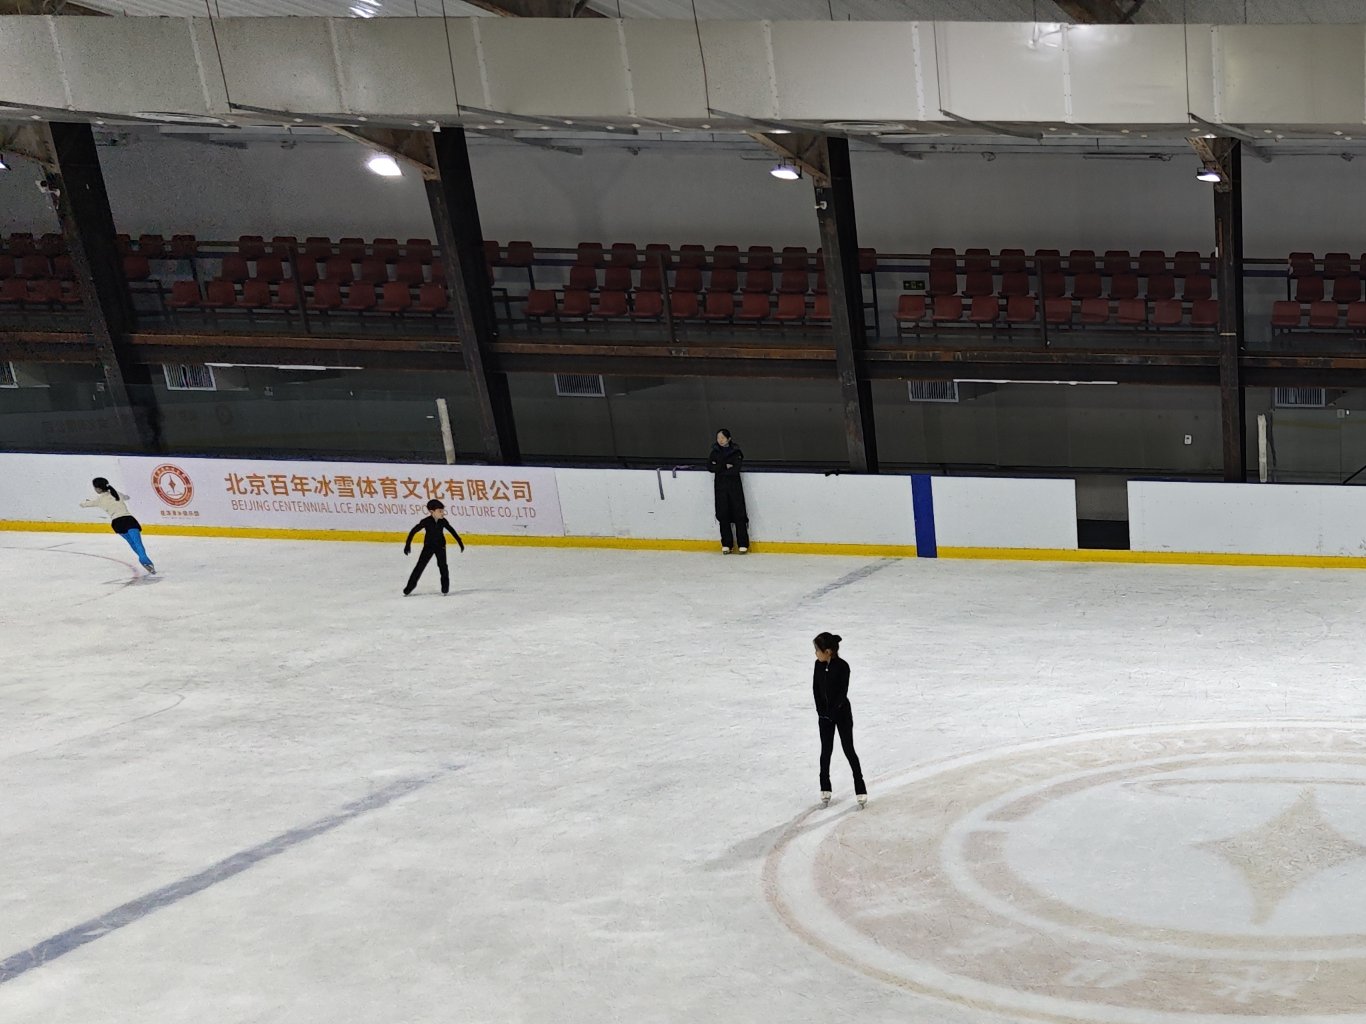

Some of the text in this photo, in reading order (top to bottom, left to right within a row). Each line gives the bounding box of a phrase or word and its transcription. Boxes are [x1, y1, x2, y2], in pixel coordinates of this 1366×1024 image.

[224, 473, 533, 502] 北京百年冰雪体育文化有限公司
[231, 499, 271, 512] BEIJING
[272, 500, 333, 513] CENTENNIAL
[355, 502, 376, 514] AND
[377, 503, 408, 515] SNOW
[451, 505, 496, 517] CULTURE
